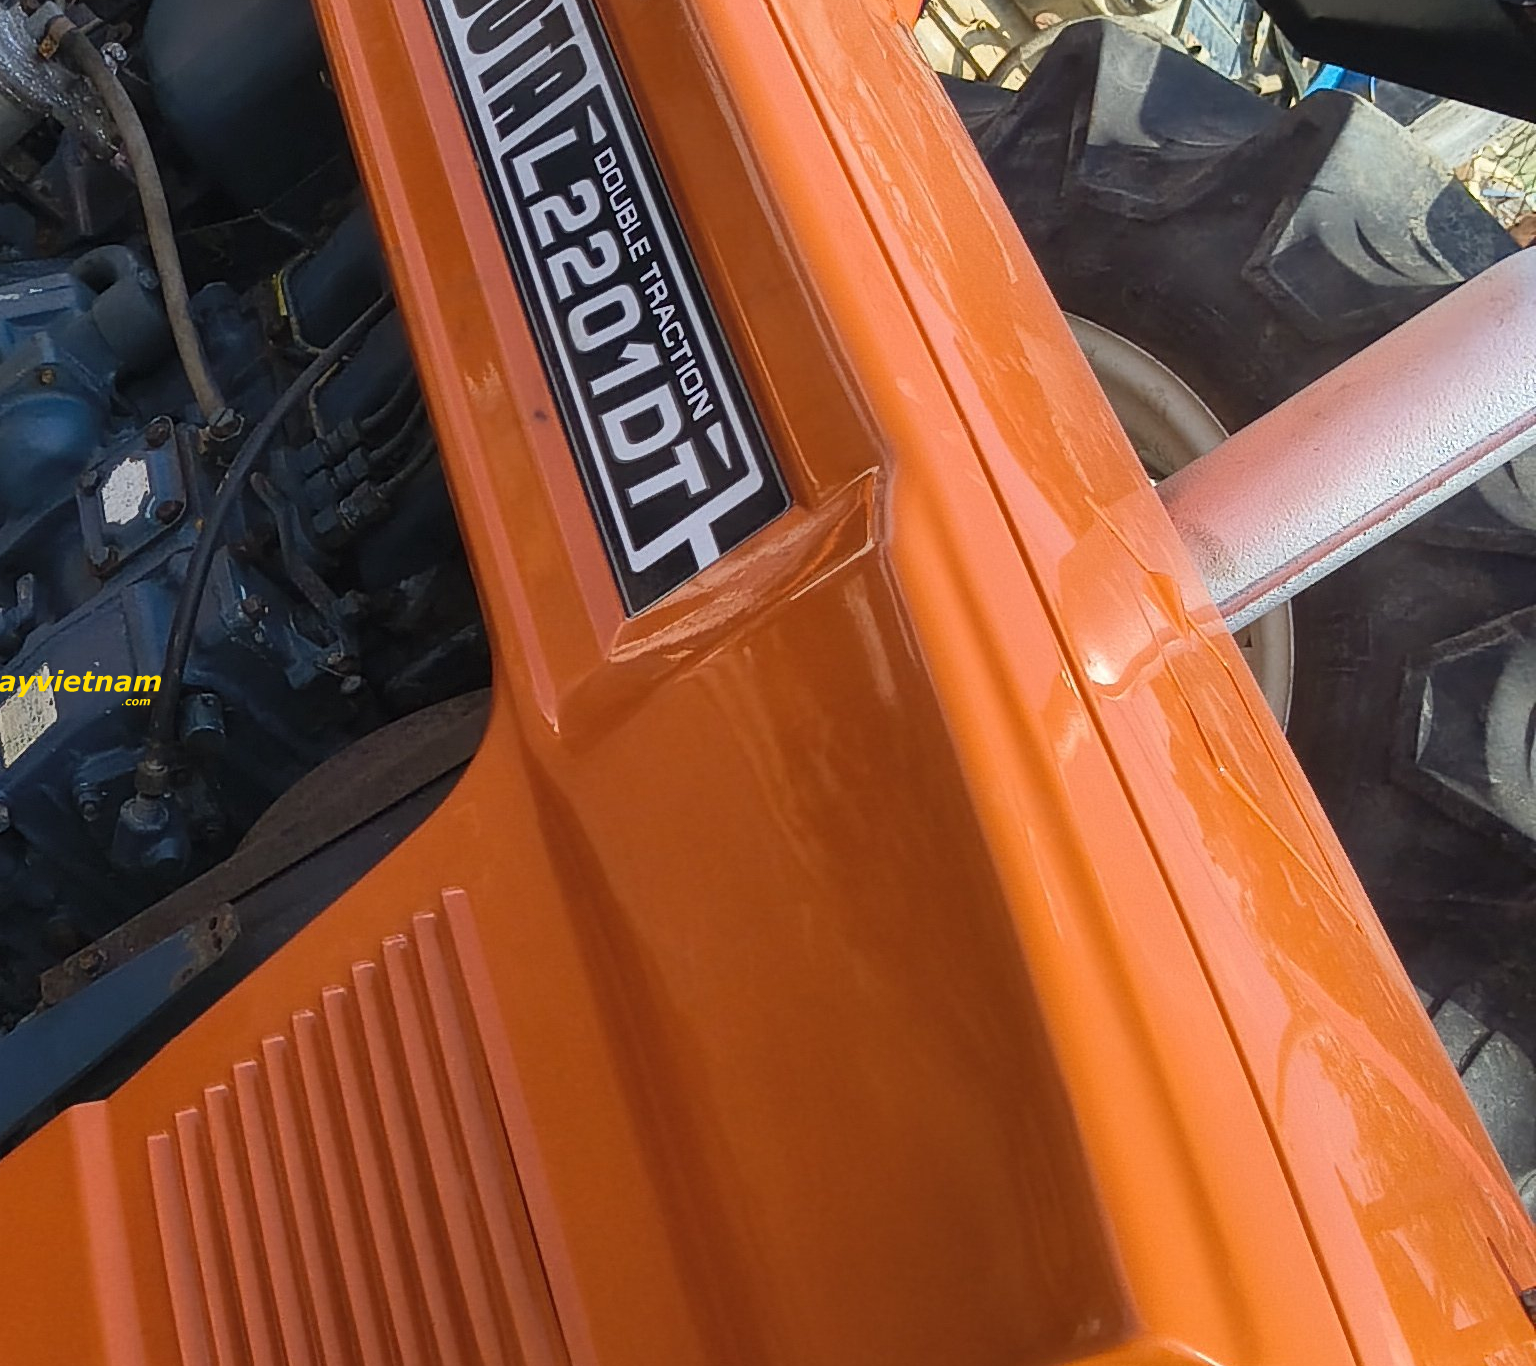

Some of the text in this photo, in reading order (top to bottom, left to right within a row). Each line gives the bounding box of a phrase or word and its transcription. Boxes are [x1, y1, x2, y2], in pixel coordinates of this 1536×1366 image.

[511, 128, 710, 507] L2201DT
[593, 146, 714, 422] DOUBLE TRACTION
